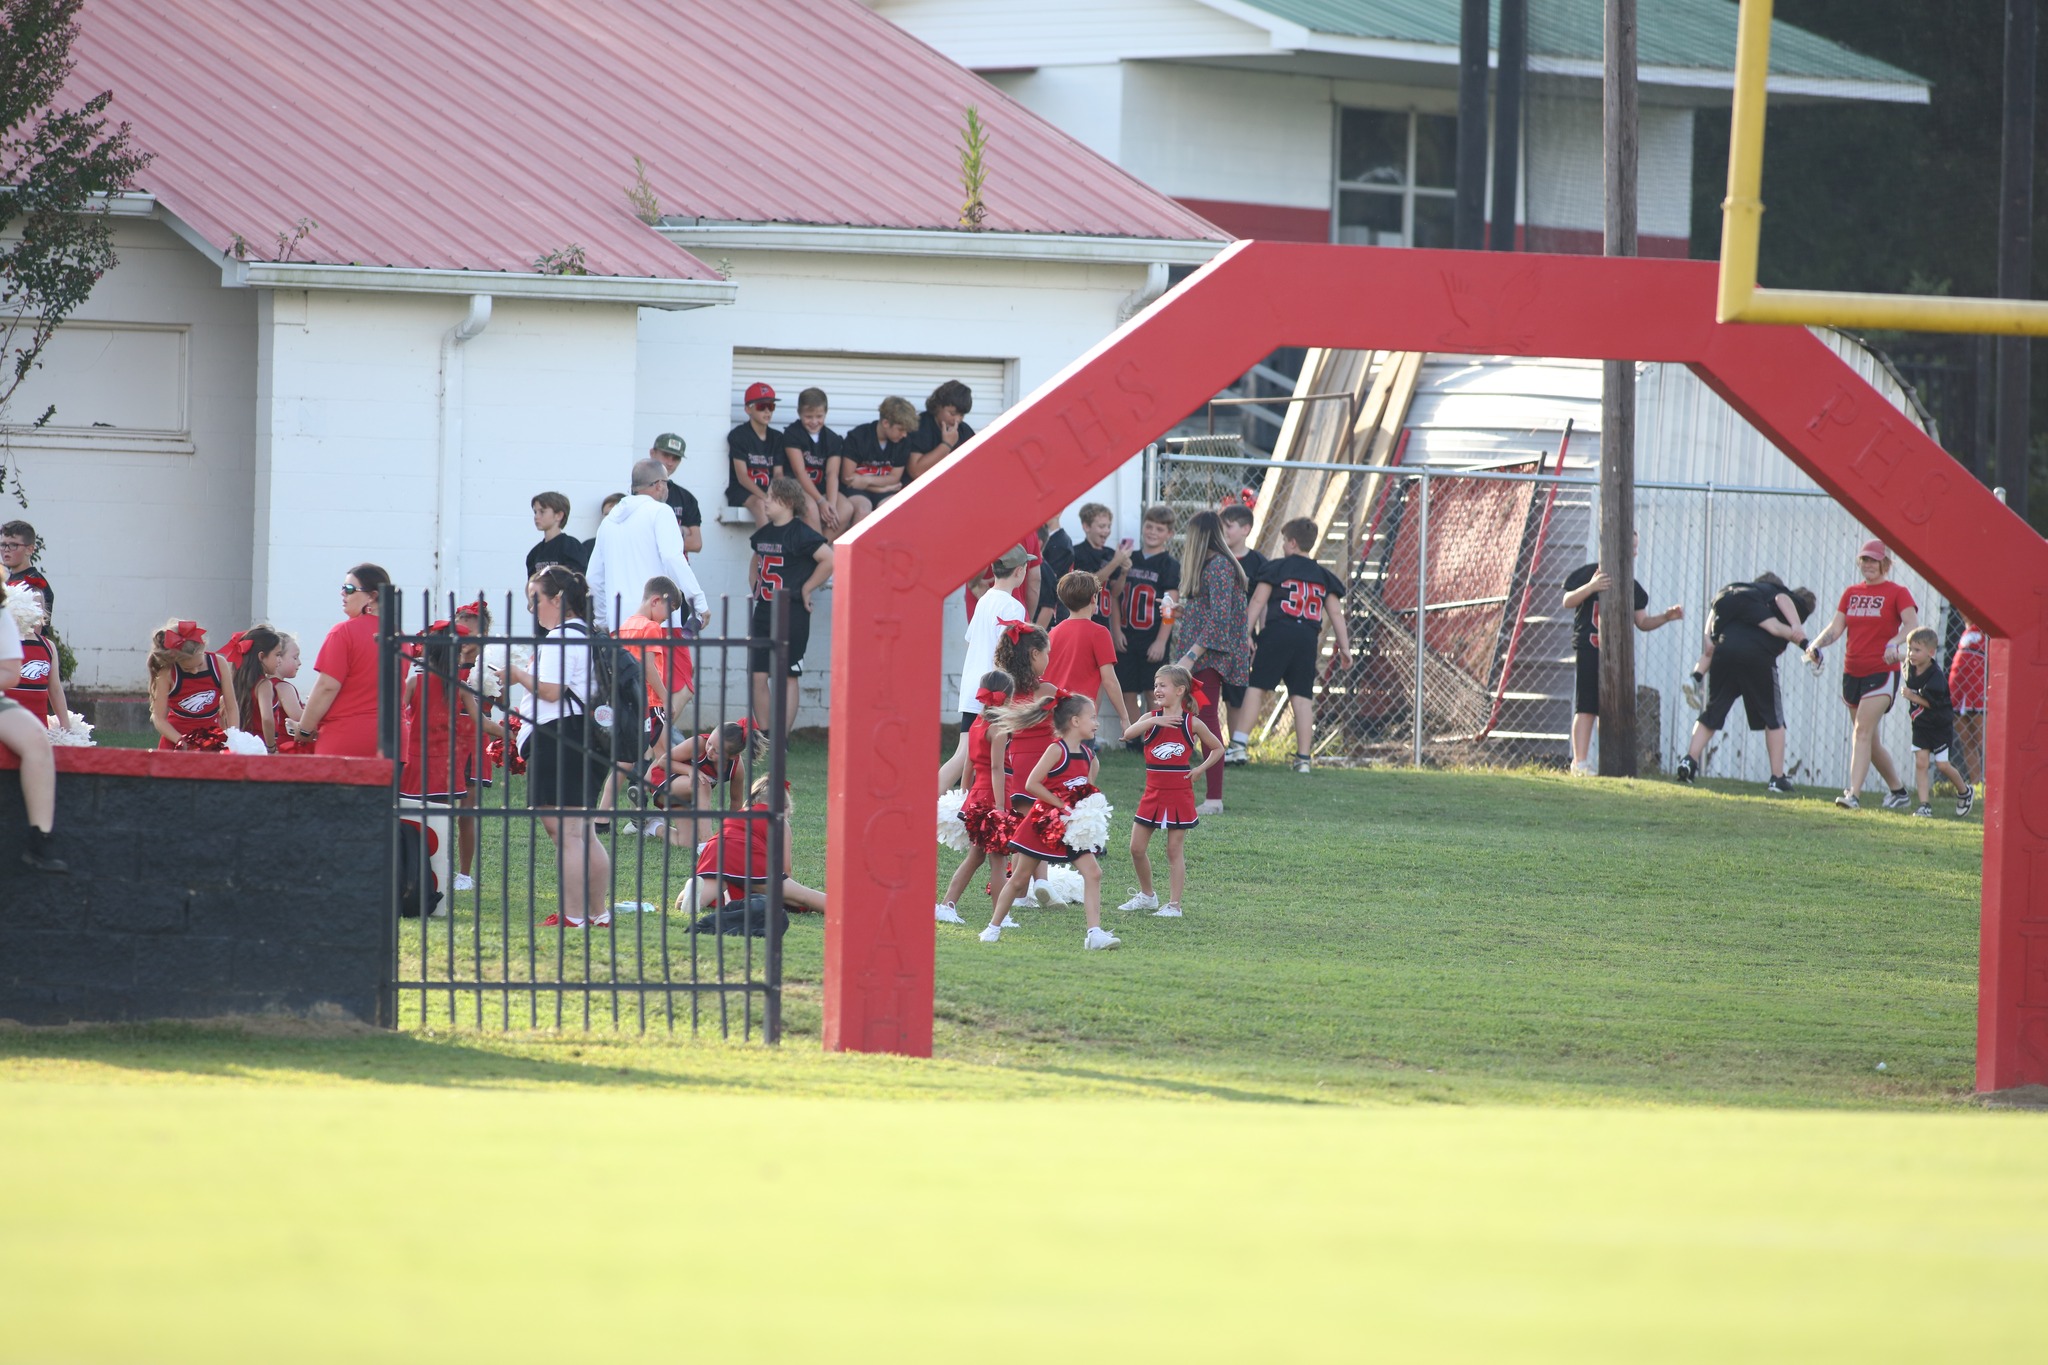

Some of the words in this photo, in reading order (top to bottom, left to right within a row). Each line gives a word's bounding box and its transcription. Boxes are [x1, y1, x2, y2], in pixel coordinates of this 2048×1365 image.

[1008, 360, 1156, 502] PHS
[1806, 384, 1950, 525] PHS
[757, 554, 784, 602] 5
[1280, 578, 1327, 622] 36
